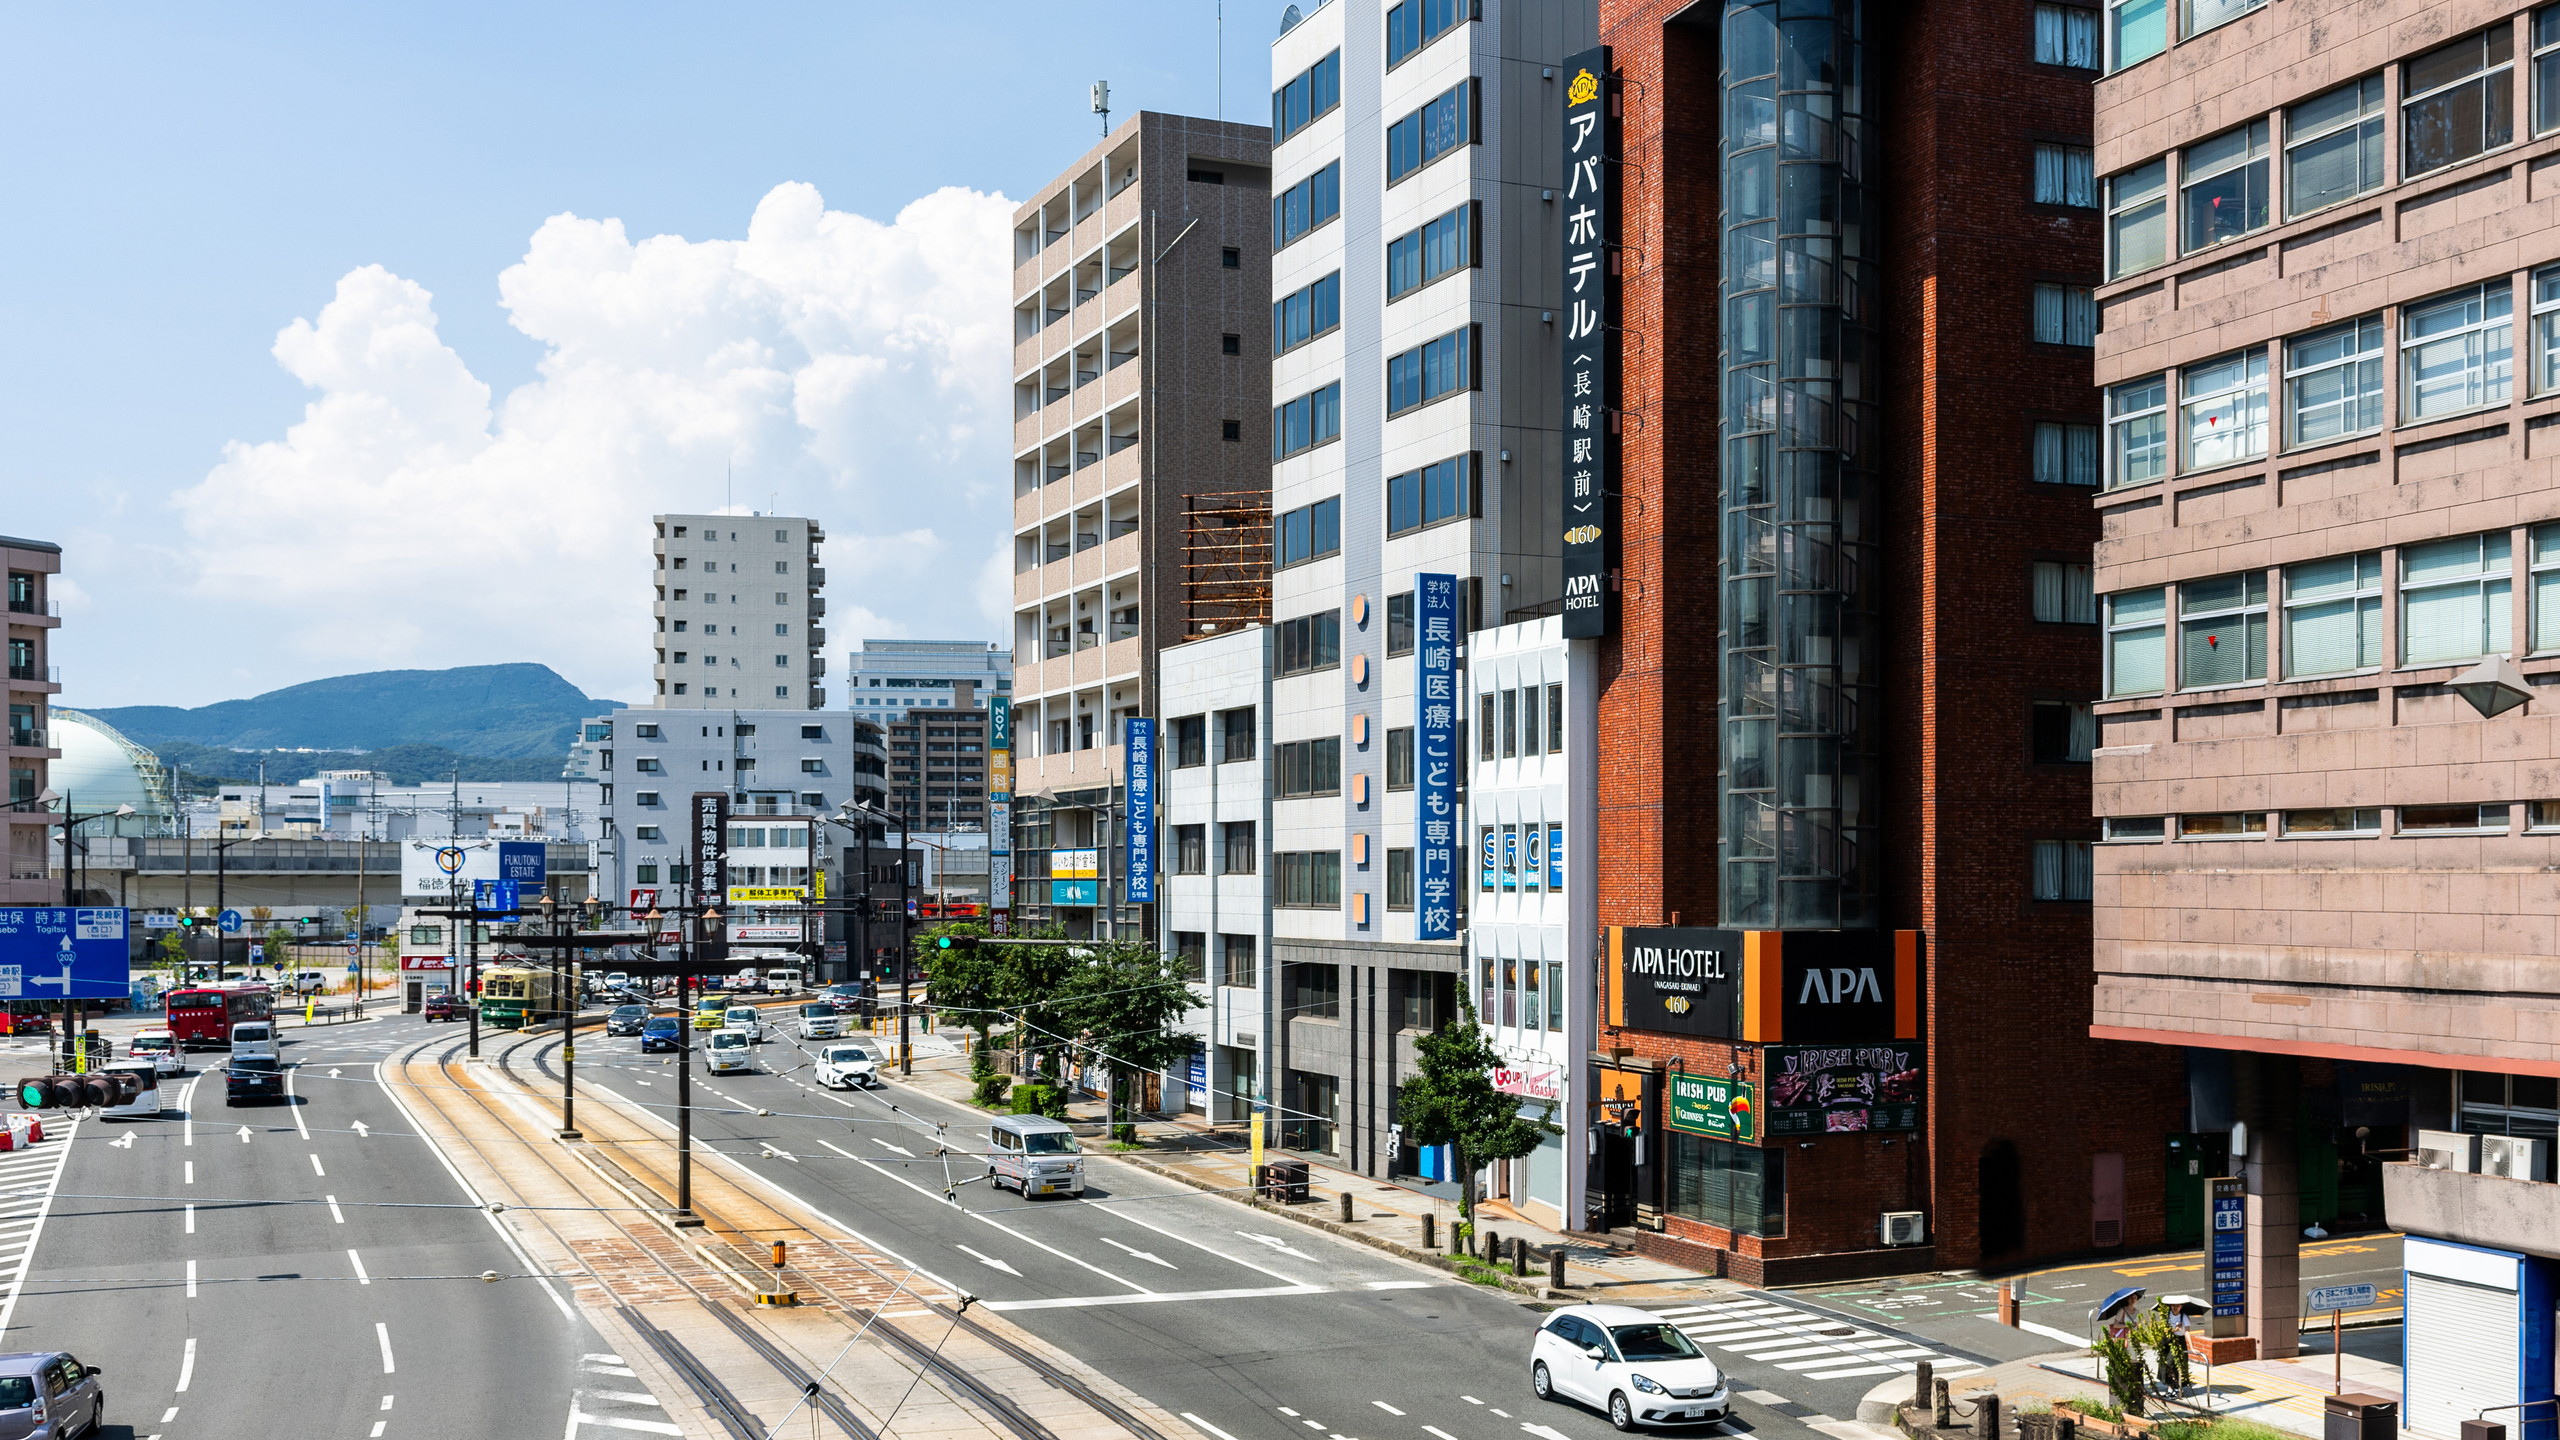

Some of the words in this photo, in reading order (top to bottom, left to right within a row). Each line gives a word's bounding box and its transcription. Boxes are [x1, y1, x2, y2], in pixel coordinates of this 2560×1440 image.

[1568, 110, 1598, 341] アパホテル
[1569, 525, 1595, 545] 160
[1426, 580, 1451, 595] 学校
[1566, 574, 1600, 597] APA
[1426, 595, 1451, 610] 法人
[1566, 596, 1600, 611] HOTEL
[995, 706, 1005, 740] NOVA
[992, 753, 1008, 790] 歯科
[1424, 615, 1452, 933] 長崎医療こども専門学校
[1132, 736, 1148, 890] 長崎医療こども専門学校
[701, 798, 718, 892] 売買物件募集
[504, 854, 541, 866] FUKUTOKU
[510, 866, 535, 878] ESTATE
[992, 861, 1000, 896] ピラティス
[35, 911, 67, 925] 時津
[36, 926, 67, 934] Togitsu
[60, 953, 74, 961] 202
[1631, 947, 1665, 975] APA
[1667, 948, 1725, 979] HOTEL
[0, 966, 20, 976] 崎駅
[1799, 967, 1882, 1004] APA
[1669, 995, 1687, 1014] 160
[1800, 1049, 1852, 1076] IRISH
[1856, 1047, 1894, 1074] PUB
[1676, 1081, 1704, 1100] IRISH
[1707, 1085, 1727, 1103] PUB
[1680, 1109, 1704, 1122] GUINNESS
[2217, 1212, 2241, 1228] 歯科
